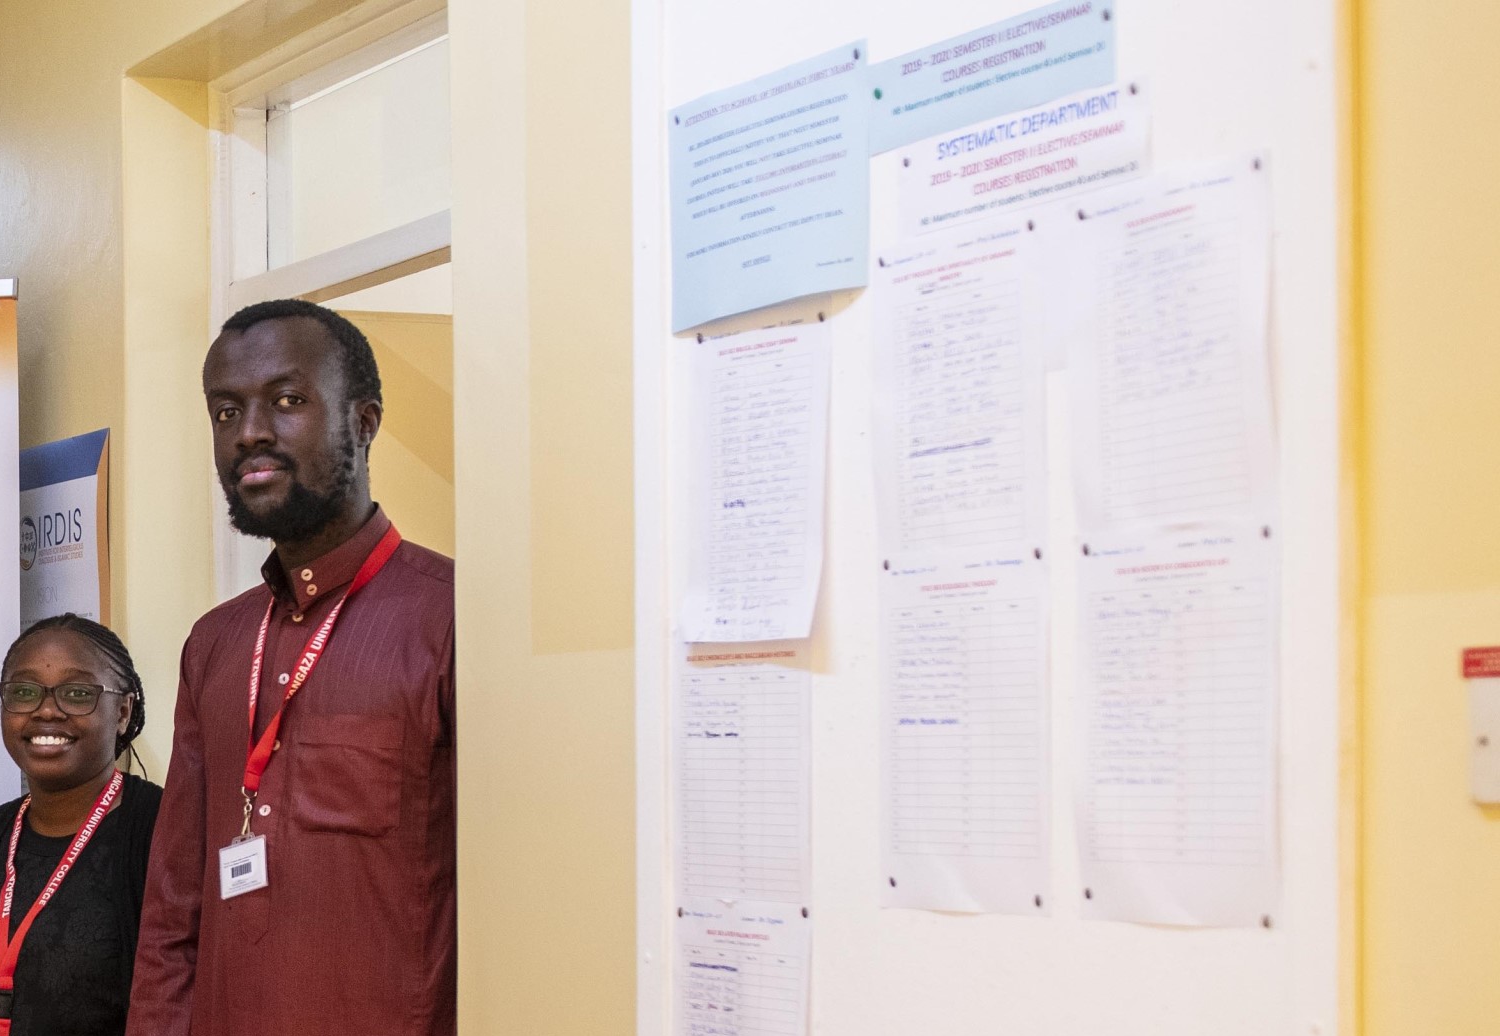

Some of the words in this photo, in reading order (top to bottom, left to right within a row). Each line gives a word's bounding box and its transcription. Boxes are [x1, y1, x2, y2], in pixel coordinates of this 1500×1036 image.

[941, 62, 981, 83] COURSES
[983, 39, 1047, 70] REGISTRATION
[953, 34, 997, 58] SEMESTER
[937, 120, 1018, 160] SYSTEMATIC
[1021, 89, 1120, 135] DEPARTMENT
[983, 148, 1028, 171] SEMESTER
[1014, 156, 1078, 184] REGISTRATION
[38, 508, 82, 549] IRDIS
[67, 807, 105, 863] UNIVERSITY
[2, 873, 16, 918] TANGAZA
[39, 864, 70, 906] COLLEGE
